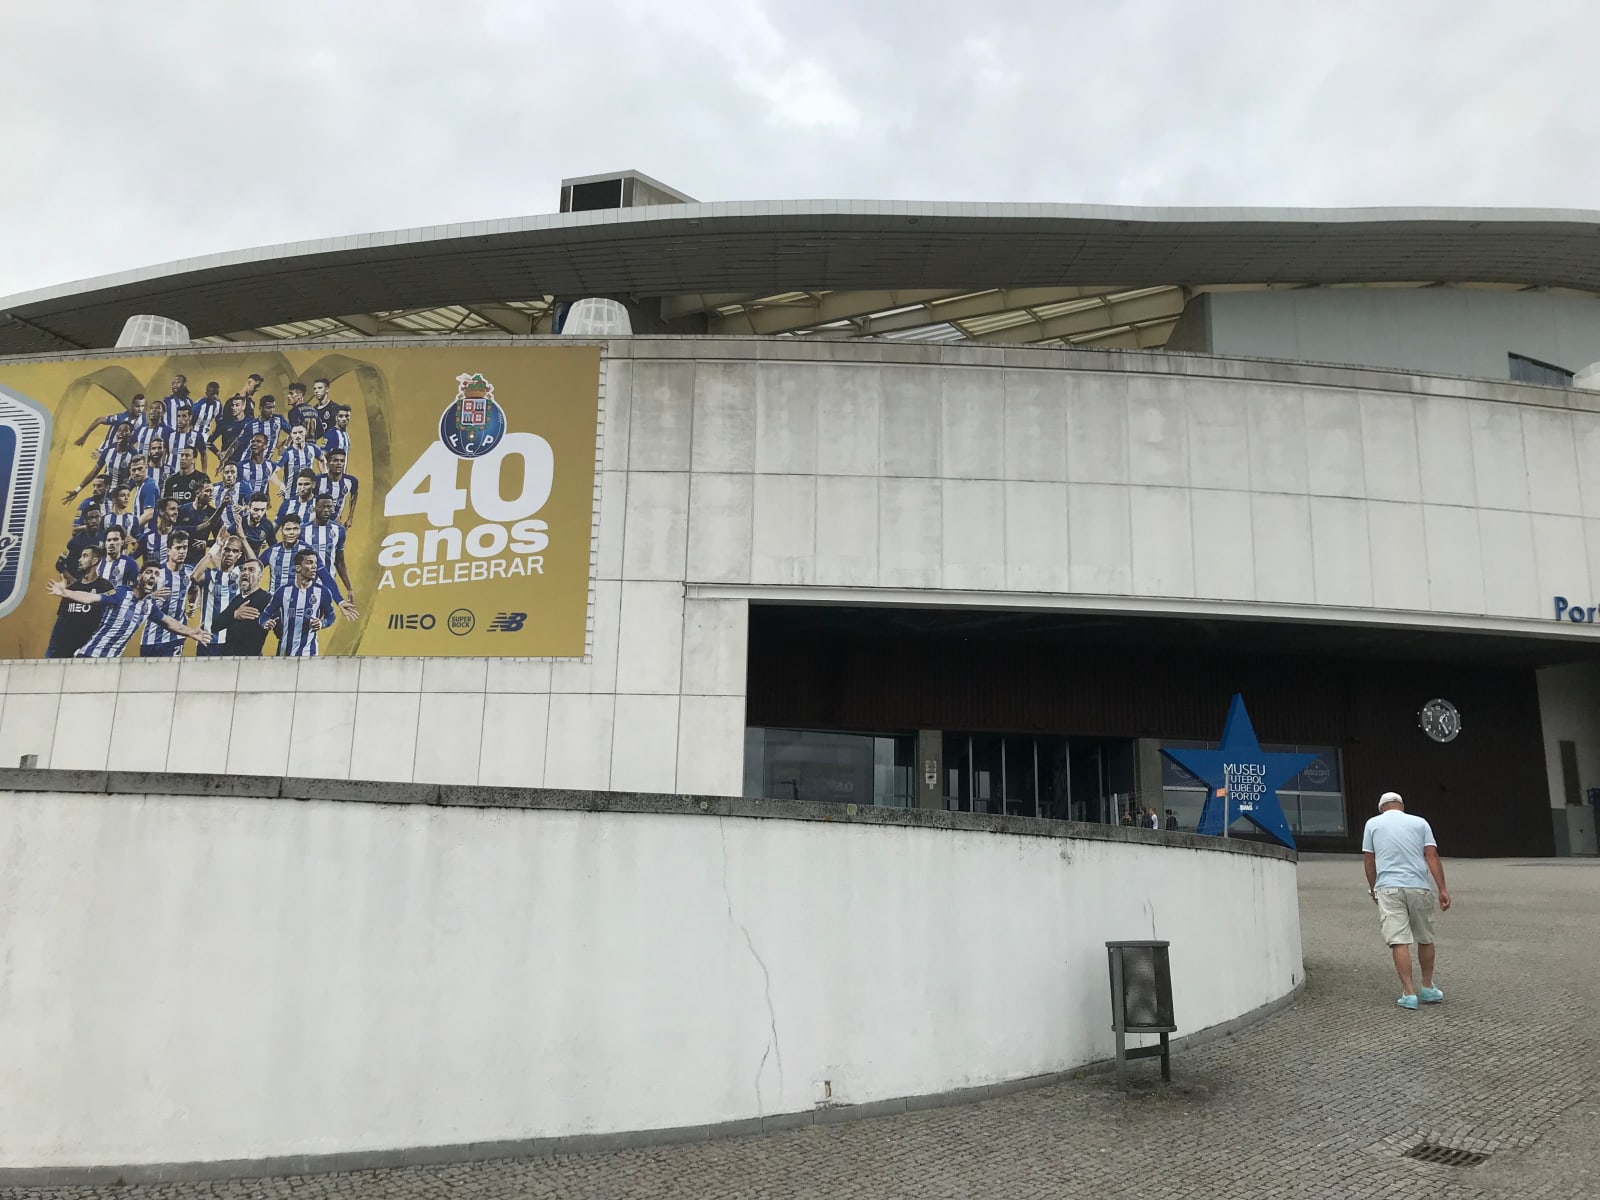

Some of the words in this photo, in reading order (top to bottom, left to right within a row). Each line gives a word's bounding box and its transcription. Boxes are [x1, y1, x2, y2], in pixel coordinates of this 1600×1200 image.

[384, 432, 554, 527] 40
[378, 519, 549, 567] anos
[378, 570, 396, 590] A
[403, 555, 544, 588] CELEBRAR
[1554, 596, 1600, 623] Por
[388, 614, 436, 630] MEO
[1223, 763, 1266, 776] MUSEU
[1227, 775, 1264, 784] UTEBOL
[1228, 783, 1252, 792] LUBE
[1253, 784, 1267, 793] DO
[1231, 792, 1261, 801] PORTO
